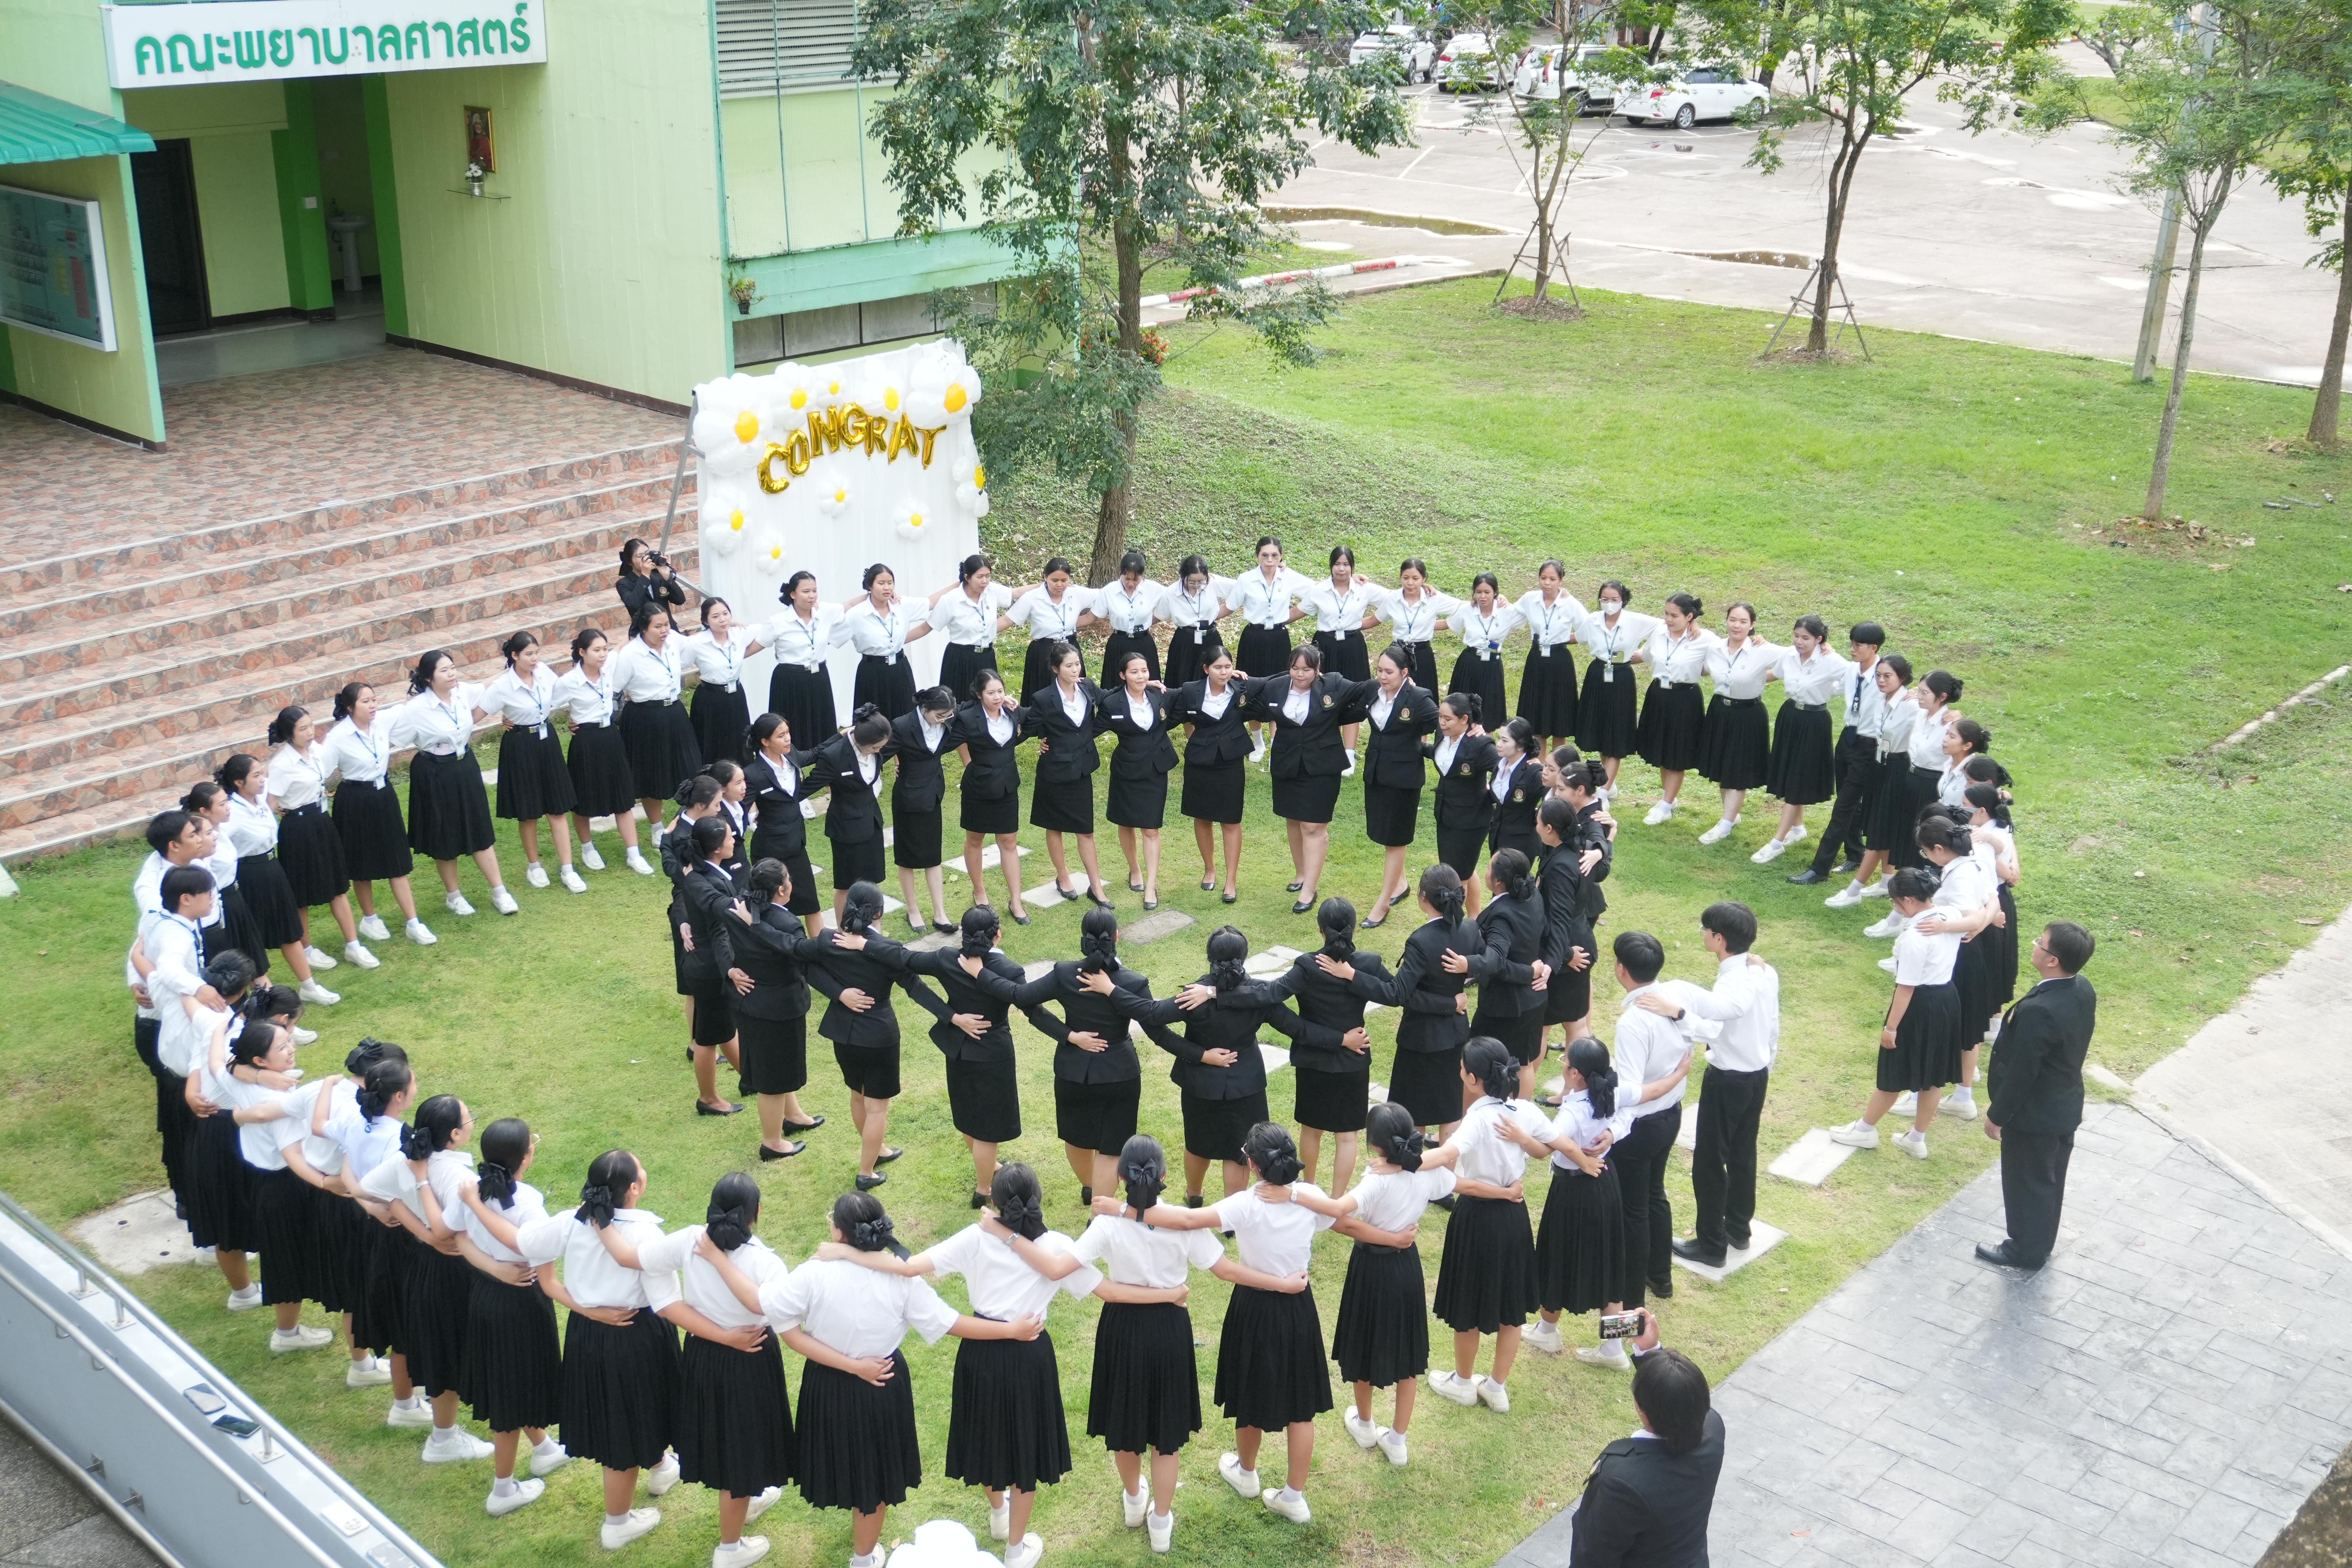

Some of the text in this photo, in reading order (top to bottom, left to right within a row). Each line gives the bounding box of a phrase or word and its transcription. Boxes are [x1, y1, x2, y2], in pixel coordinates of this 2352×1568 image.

[135, 3, 531, 75] คณะพยาบาลศาสตร์
[757, 402, 947, 495] CONGRAT
